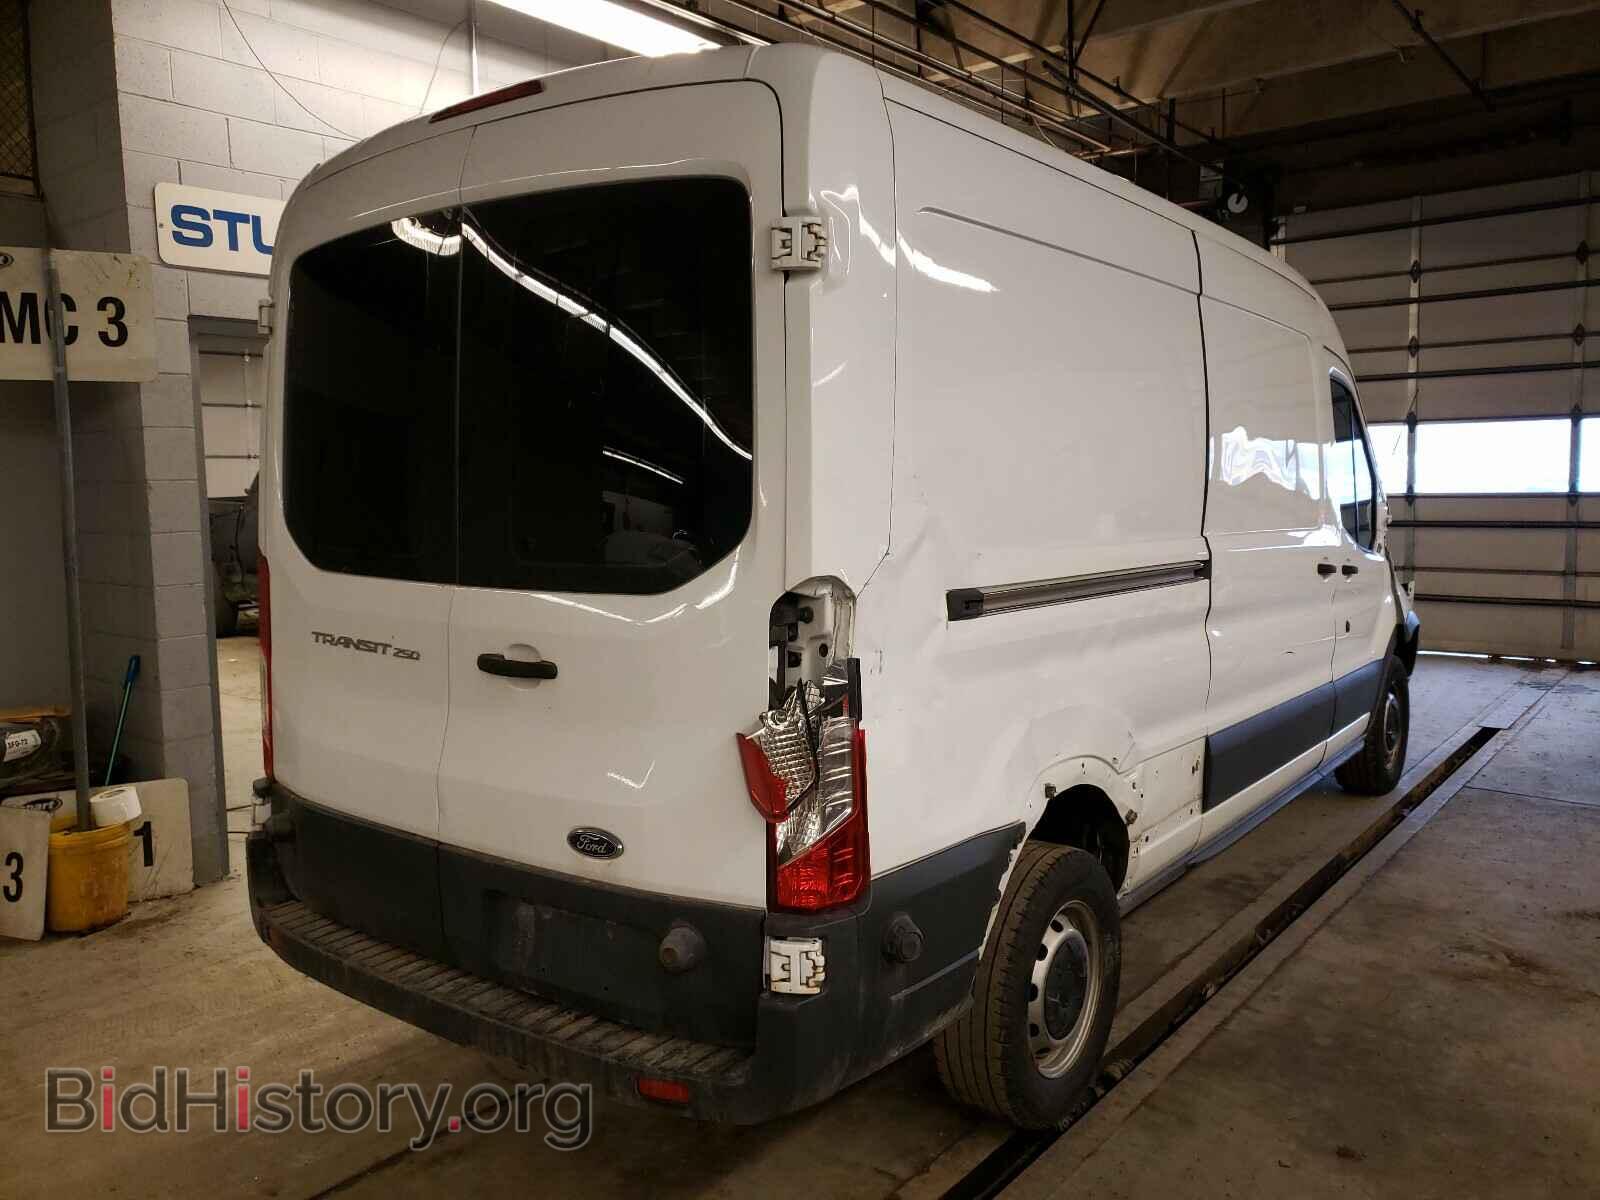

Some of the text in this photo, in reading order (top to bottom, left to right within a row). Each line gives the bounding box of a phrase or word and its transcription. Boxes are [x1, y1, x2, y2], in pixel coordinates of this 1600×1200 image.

[97, 296, 128, 347] 3
[311, 631, 421, 660] TRANSIT 250
[133, 821, 154, 867] 1
[576, 834, 608, 853] Ford
[3, 852, 24, 903] 3
